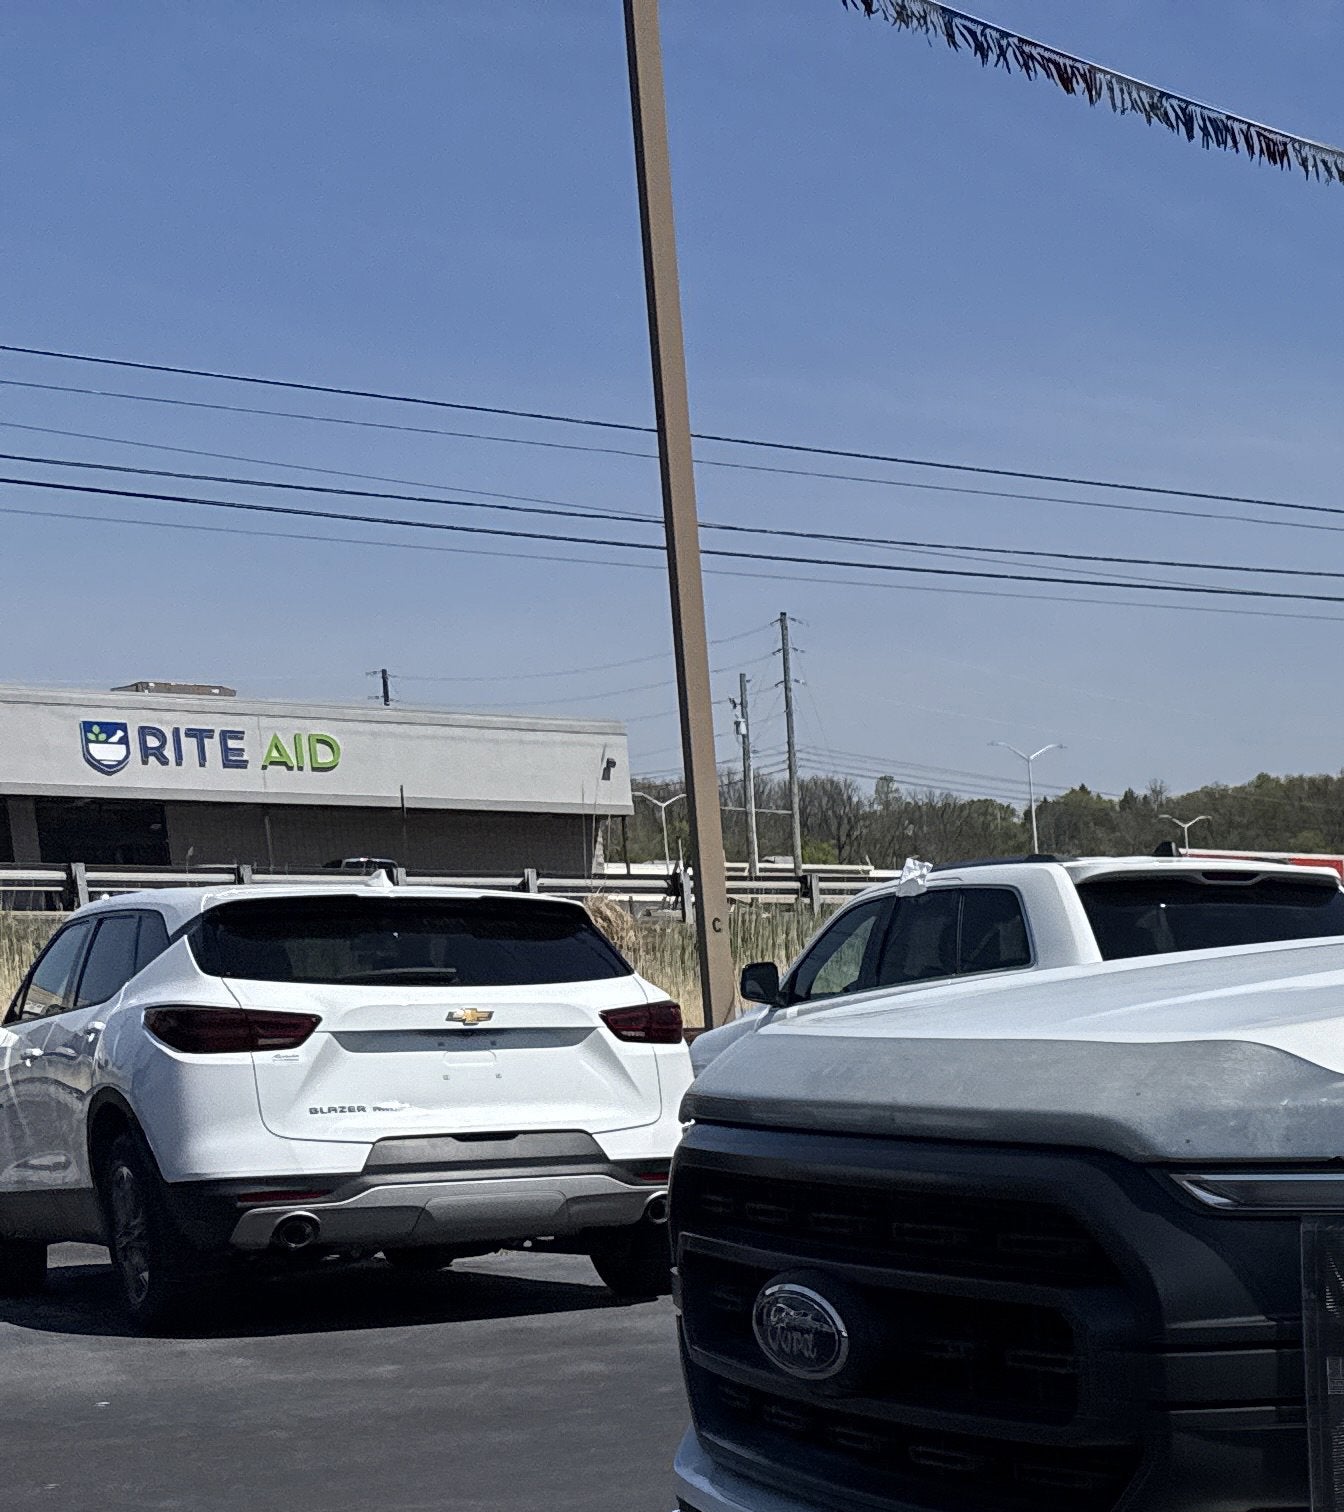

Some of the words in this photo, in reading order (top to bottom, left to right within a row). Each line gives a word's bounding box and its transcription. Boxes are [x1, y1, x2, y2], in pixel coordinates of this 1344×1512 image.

[138, 726, 249, 769] RITE
[261, 732, 341, 773] AID
[711, 917, 722, 933] C
[308, 1105, 367, 1115] BLAZER
